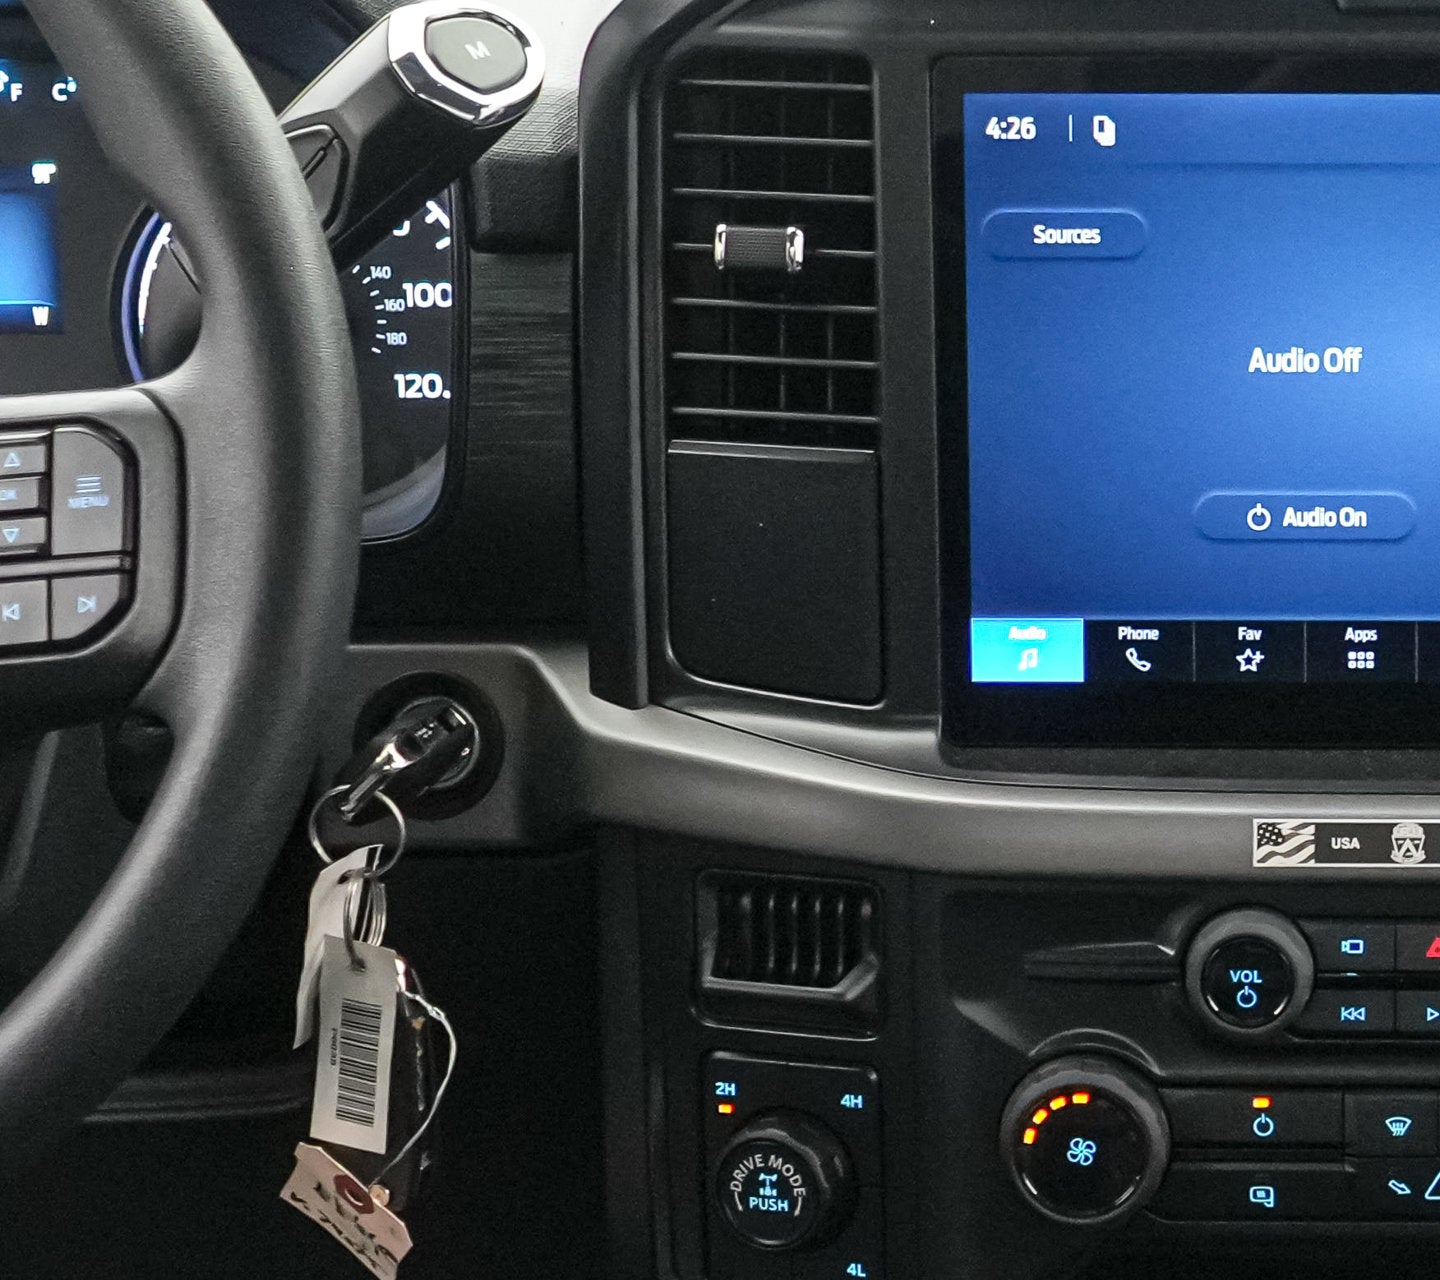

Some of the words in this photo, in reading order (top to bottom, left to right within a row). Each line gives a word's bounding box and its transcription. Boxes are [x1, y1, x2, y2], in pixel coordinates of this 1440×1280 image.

[464, 41, 491, 60] M
[10, 83, 23, 102] F
[51, 83, 67, 101] C
[985, 116, 1037, 140] 4:26
[1033, 224, 1101, 244] Sources
[370, 265, 392, 279] 140
[402, 282, 453, 308] 100
[383, 298, 406, 312] 160
[32, 306, 50, 326] W
[386, 332, 408, 346] 180
[1248, 346, 1320, 373] Audio
[1323, 346, 1363, 373] Off
[394, 373, 444, 399] 120
[67, 495, 110, 509] MENU
[1282, 506, 1337, 527] Audio
[1339, 506, 1367, 527] On
[1008, 626, 1047, 640] Audio
[1117, 626, 1160, 641] Phone
[1238, 626, 1263, 640] Fav
[1344, 627, 1378, 643] Apps
[1331, 837, 1360, 850] USA
[1230, 969, 1262, 983] VOL
[715, 1081, 736, 1096] 2H
[840, 1094, 863, 1109] 4H
[730, 1153, 765, 1192] DRIVE
[768, 1154, 806, 1197] MODE
[749, 1196, 789, 1211] PUSH
[846, 1263, 867, 1277] 4L
